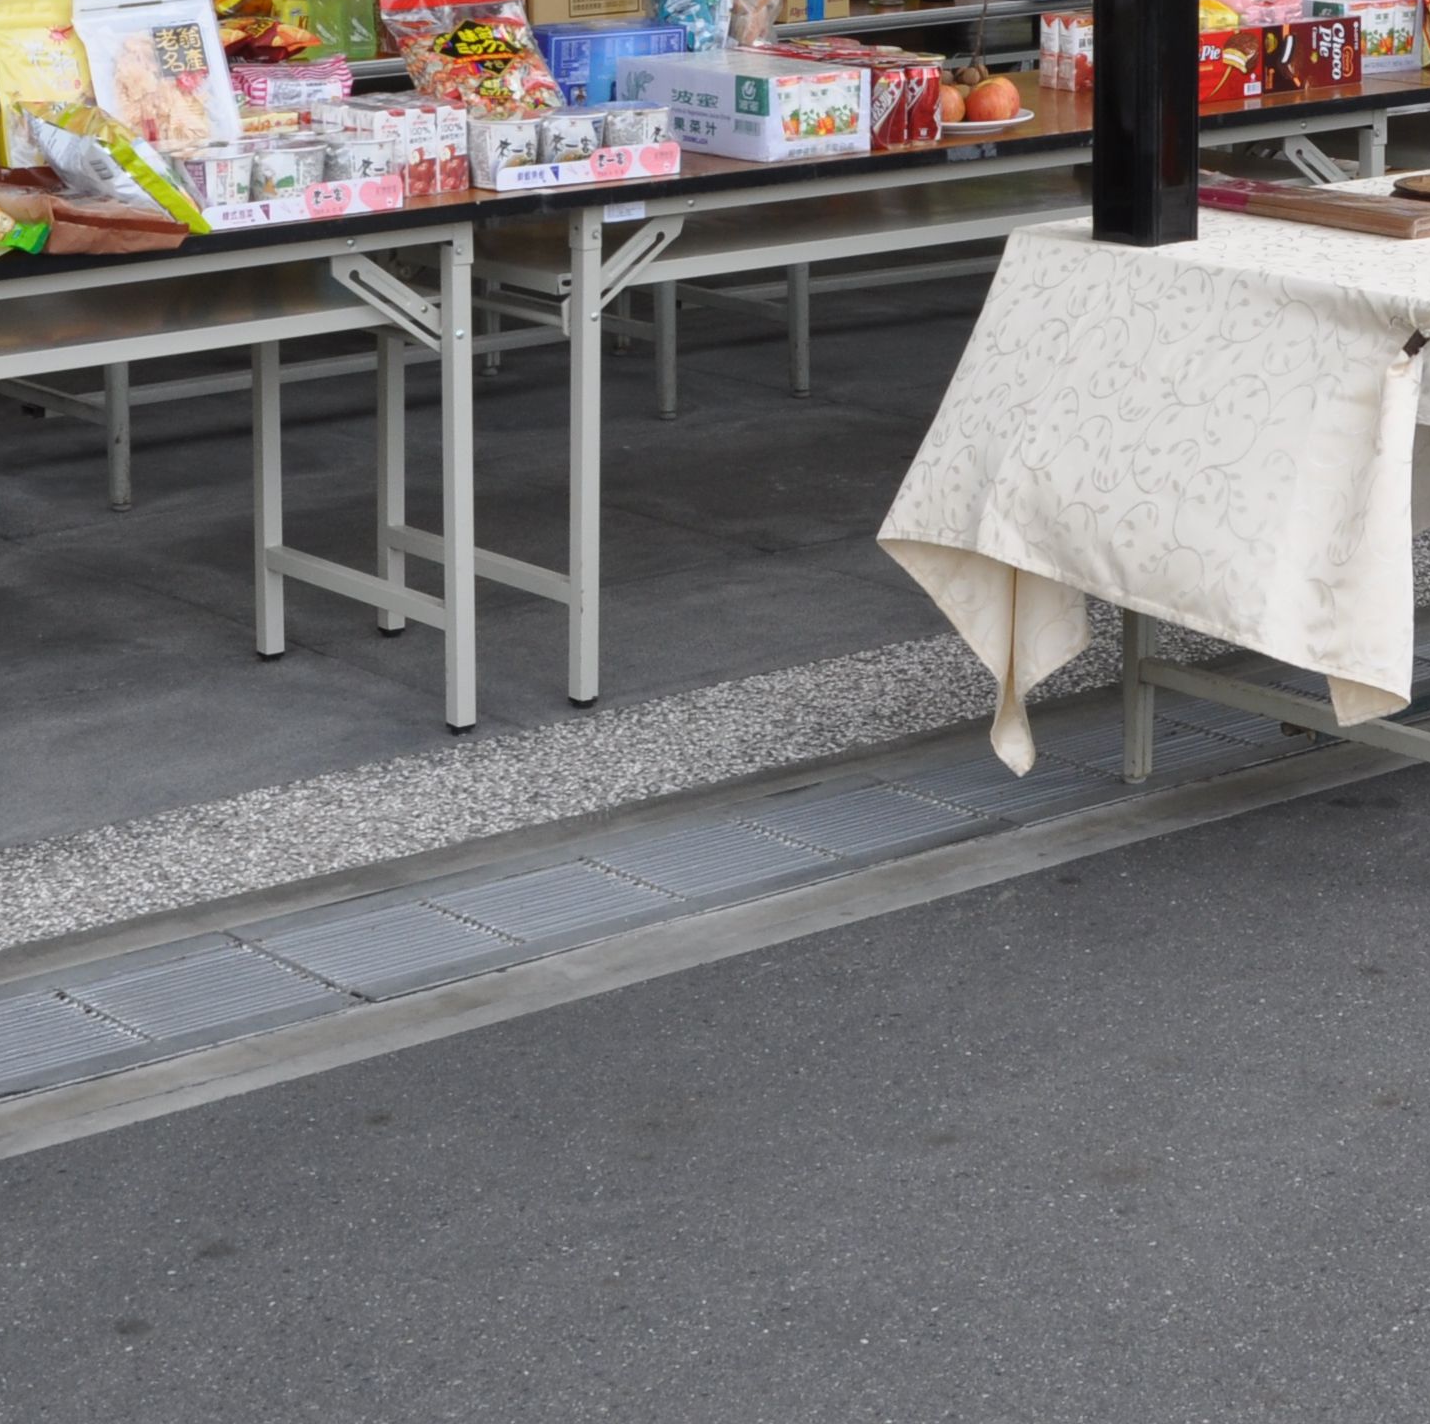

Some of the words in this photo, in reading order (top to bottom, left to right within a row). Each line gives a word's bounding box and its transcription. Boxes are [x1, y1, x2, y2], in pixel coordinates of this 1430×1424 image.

[1319, 26, 1331, 58] Pie
[1332, 22, 1345, 80] Choco
[1200, 45, 1222, 62] Pie
[671, 87, 720, 108] 波蜜
[673, 117, 718, 136] 果菜汁
